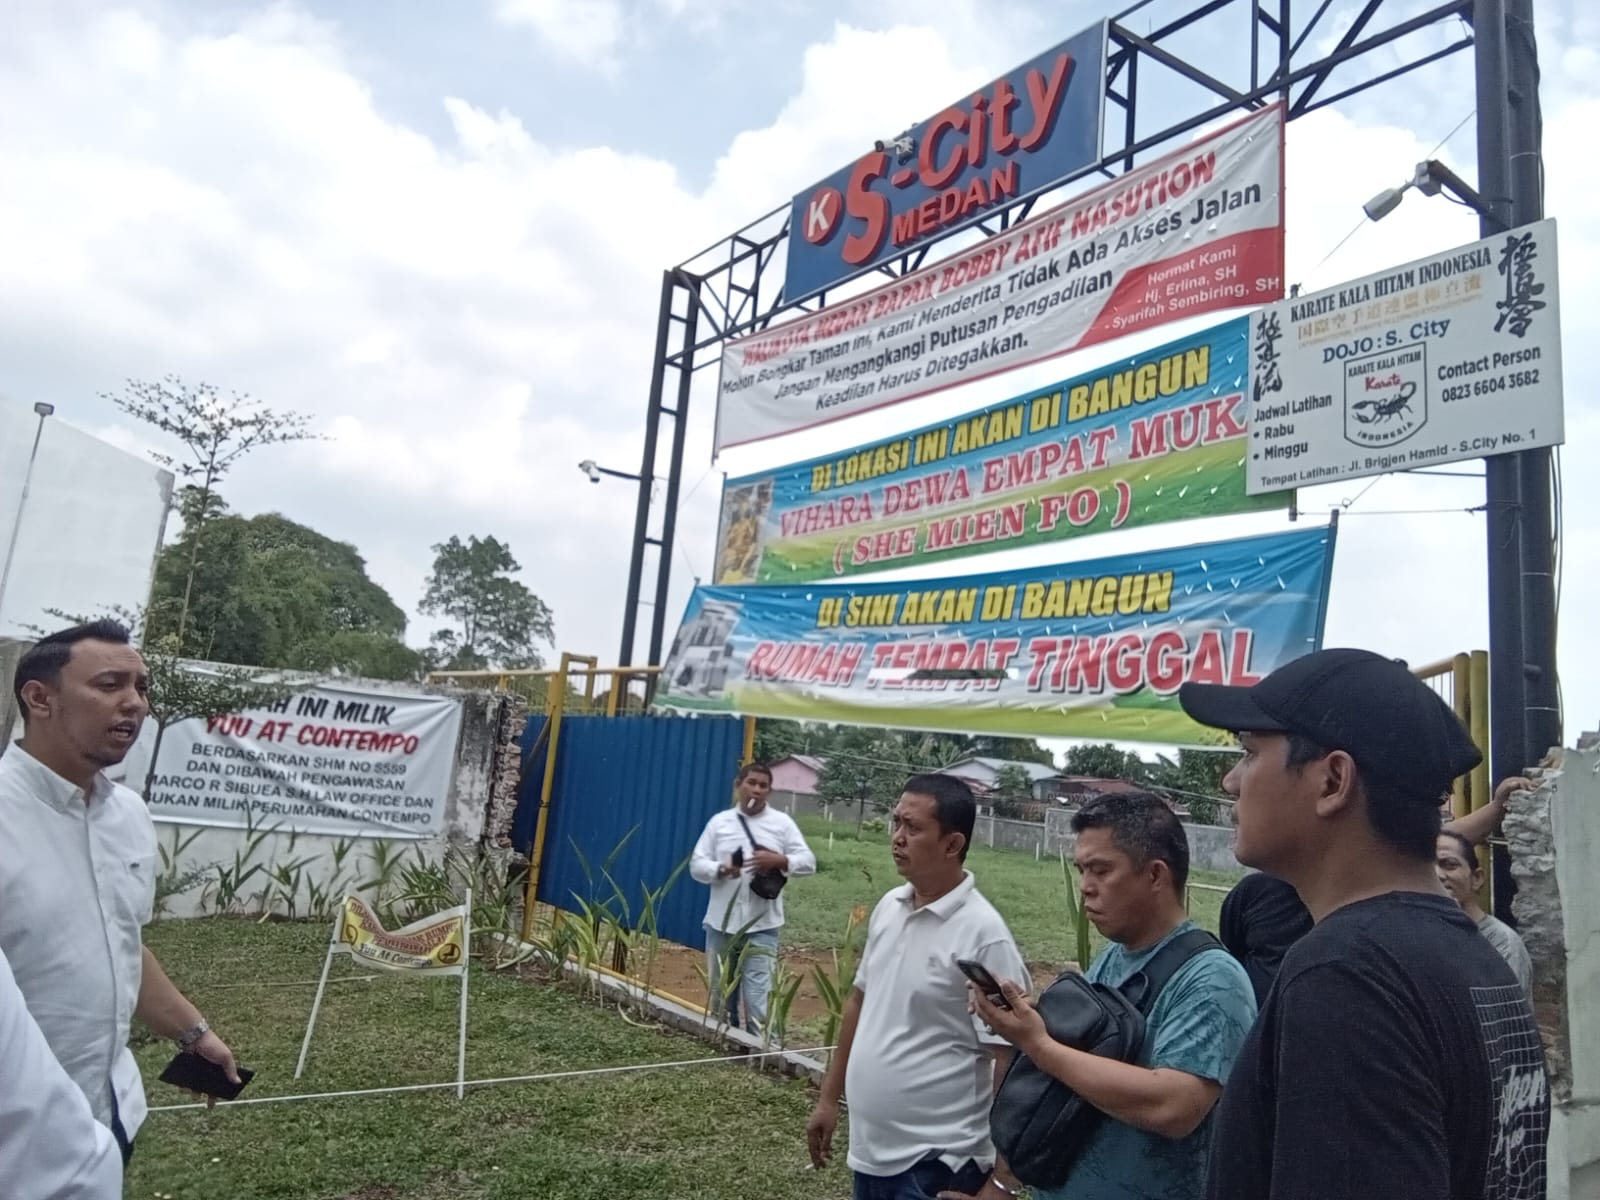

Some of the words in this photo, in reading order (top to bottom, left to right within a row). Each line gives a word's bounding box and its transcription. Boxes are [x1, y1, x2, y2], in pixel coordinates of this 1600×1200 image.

[806, 191, 832, 239] K
[842, 53, 1075, 264] S-City
[892, 161, 1018, 247] MEDAN
[939, 241, 1011, 293] BOBBY
[1070, 151, 1216, 237] NASUTION
[757, 355, 808, 383] Bongkar
[809, 342, 850, 367] Taman
[877, 313, 916, 340] Kami
[918, 283, 1001, 328] Menderita
[1008, 257, 1060, 294] Tidak
[1065, 242, 1108, 273] Ada
[1114, 210, 1182, 253] Akses
[1190, 183, 1261, 225] Jalan
[1145, 289, 1162, 304] Hj.
[1166, 275, 1210, 297] Erlina,
[1214, 265, 1237, 281] SH
[1147, 257, 1195, 285] Hormat
[1199, 244, 1237, 266] Kami
[1112, 304, 1165, 329] Syarifah
[1167, 283, 1249, 311] Sembiring,
[1255, 277, 1280, 292] SH
[1290, 294, 1336, 323] KARATE
[1339, 283, 1371, 308] KALA
[1374, 270, 1415, 298] HITAM
[1419, 247, 1492, 285] INDONESIA
[774, 376, 821, 400] Jangan
[824, 334, 925, 384] Mengangkangi
[930, 314, 998, 351] Putusan
[1003, 269, 1112, 325] Pengadilan
[1410, 318, 1452, 340] City
[815, 380, 874, 411] Keadilan
[877, 367, 921, 393] Harus
[925, 332, 1028, 378] Ditegakkan.
[1348, 361, 1375, 378] KARATE
[1377, 357, 1395, 371] KALA
[1397, 351, 1421, 365] HITAM
[1438, 355, 1490, 381] Contact
[1493, 346, 1541, 369] Person
[1442, 383, 1471, 403] 0823
[1473, 376, 1506, 396] 6604
[1508, 368, 1541, 390] 3682
[810, 465, 833, 493] DI
[834, 439, 910, 487] LOKASI
[913, 428, 949, 466] INI
[951, 404, 1024, 457] AKAN
[1028, 391, 1064, 434] DI
[1067, 345, 1211, 423] BANGUN
[1254, 402, 1290, 422] Jadwal
[1292, 394, 1332, 414] Latihan
[1264, 423, 1294, 440] Rabu
[1357, 421, 1414, 441] INDONESIA
[780, 492, 873, 538] VIHARA
[882, 466, 971, 518] DEWA
[981, 424, 1116, 495] EMPAT
[1128, 392, 1249, 461] MUK
[1261, 473, 1297, 487] Tempat
[1348, 460, 1361, 472] Jl.
[1365, 453, 1406, 469] Brigjen
[1409, 445, 1448, 461] Hamid
[1459, 436, 1498, 452] S.City
[1502, 432, 1525, 445] No.
[1529, 428, 1536, 439] 1
[1264, 442, 1309, 461] Minggu
[851, 526, 918, 567] SHE
[926, 501, 1028, 551] MIEN
[1036, 485, 1101, 533] FO
[817, 597, 844, 628] DI
[845, 593, 900, 628] SINI
[900, 587, 978, 626] AKAN
[980, 585, 1017, 622] DI
[1020, 570, 1174, 621] BANGUN
[747, 639, 866, 687] RUMAH
[867, 637, 1020, 690] TEMPAT
[1026, 628, 1263, 695] TINGGAL
[296, 696, 330, 719] INI
[333, 700, 396, 726] MILIK
[256, 720, 293, 743] AT
[297, 724, 419, 755] CONTEMPO
[186, 760, 221, 775] DAN
[225, 764, 297, 783] DIBAWAH
[301, 772, 406, 791] PENGAWASAN
[191, 743, 309, 768] BERDASARKAN
[313, 757, 345, 770] SHM
[349, 761, 371, 774] NO
[203, 797, 247, 811] MILIK
[251, 800, 348, 819] PERUMAHAN
[351, 808, 431, 825] CONTEMPO
[209, 780, 221, 792] R
[224, 781, 281, 797] SIBUEA
[315, 791, 347, 803] LAW
[350, 792, 400, 807] OFFICE
[404, 796, 434, 809] DAN
